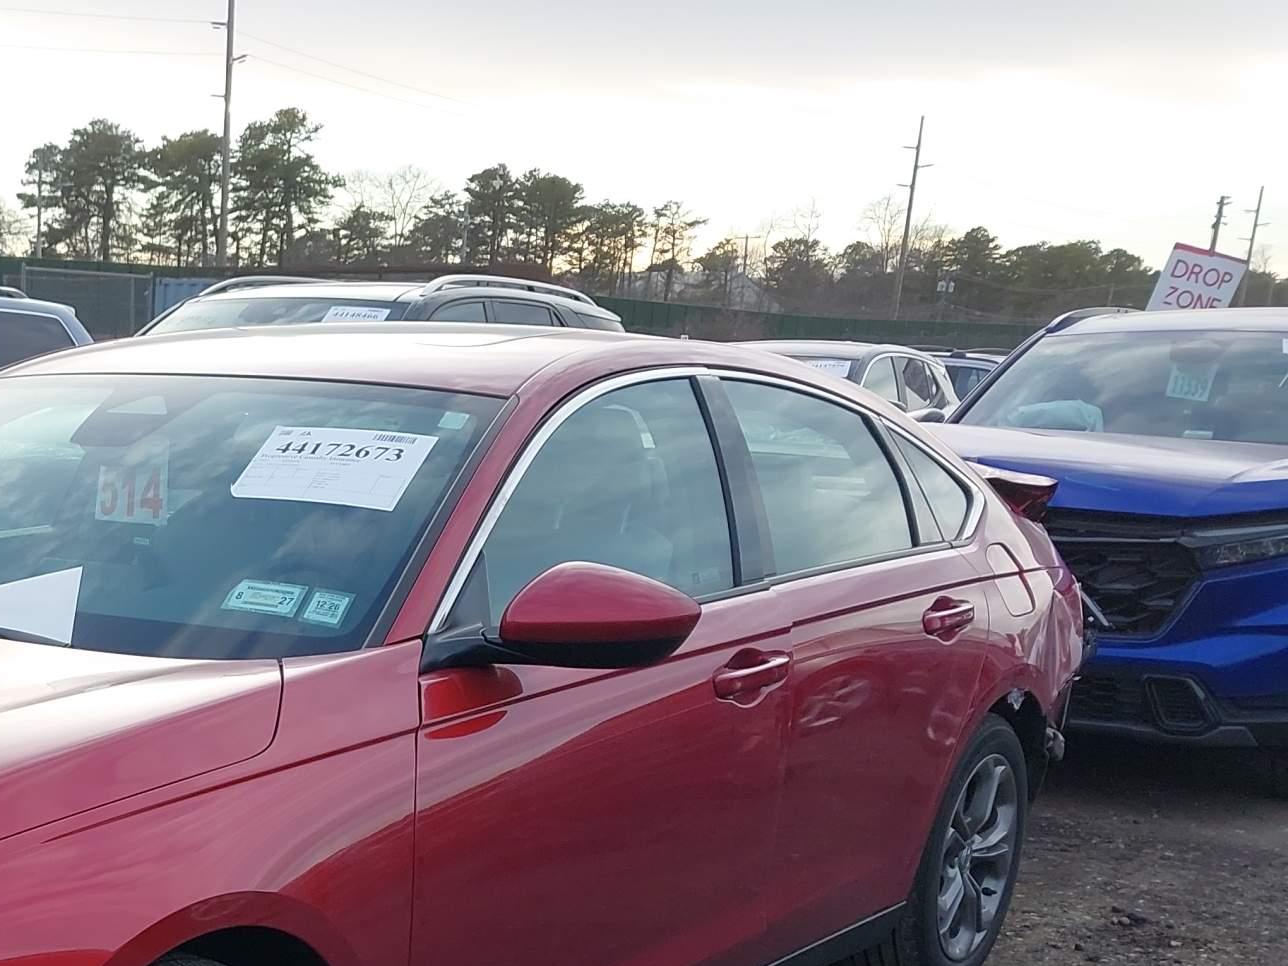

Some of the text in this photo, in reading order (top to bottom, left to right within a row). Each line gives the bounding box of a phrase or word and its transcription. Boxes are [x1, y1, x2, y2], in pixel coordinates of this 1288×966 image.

[1170, 258, 1234, 290] DROP
[276, 441, 405, 462] 44172673
[235, 592, 245, 600] 8
[277, 596, 296, 606] 27
